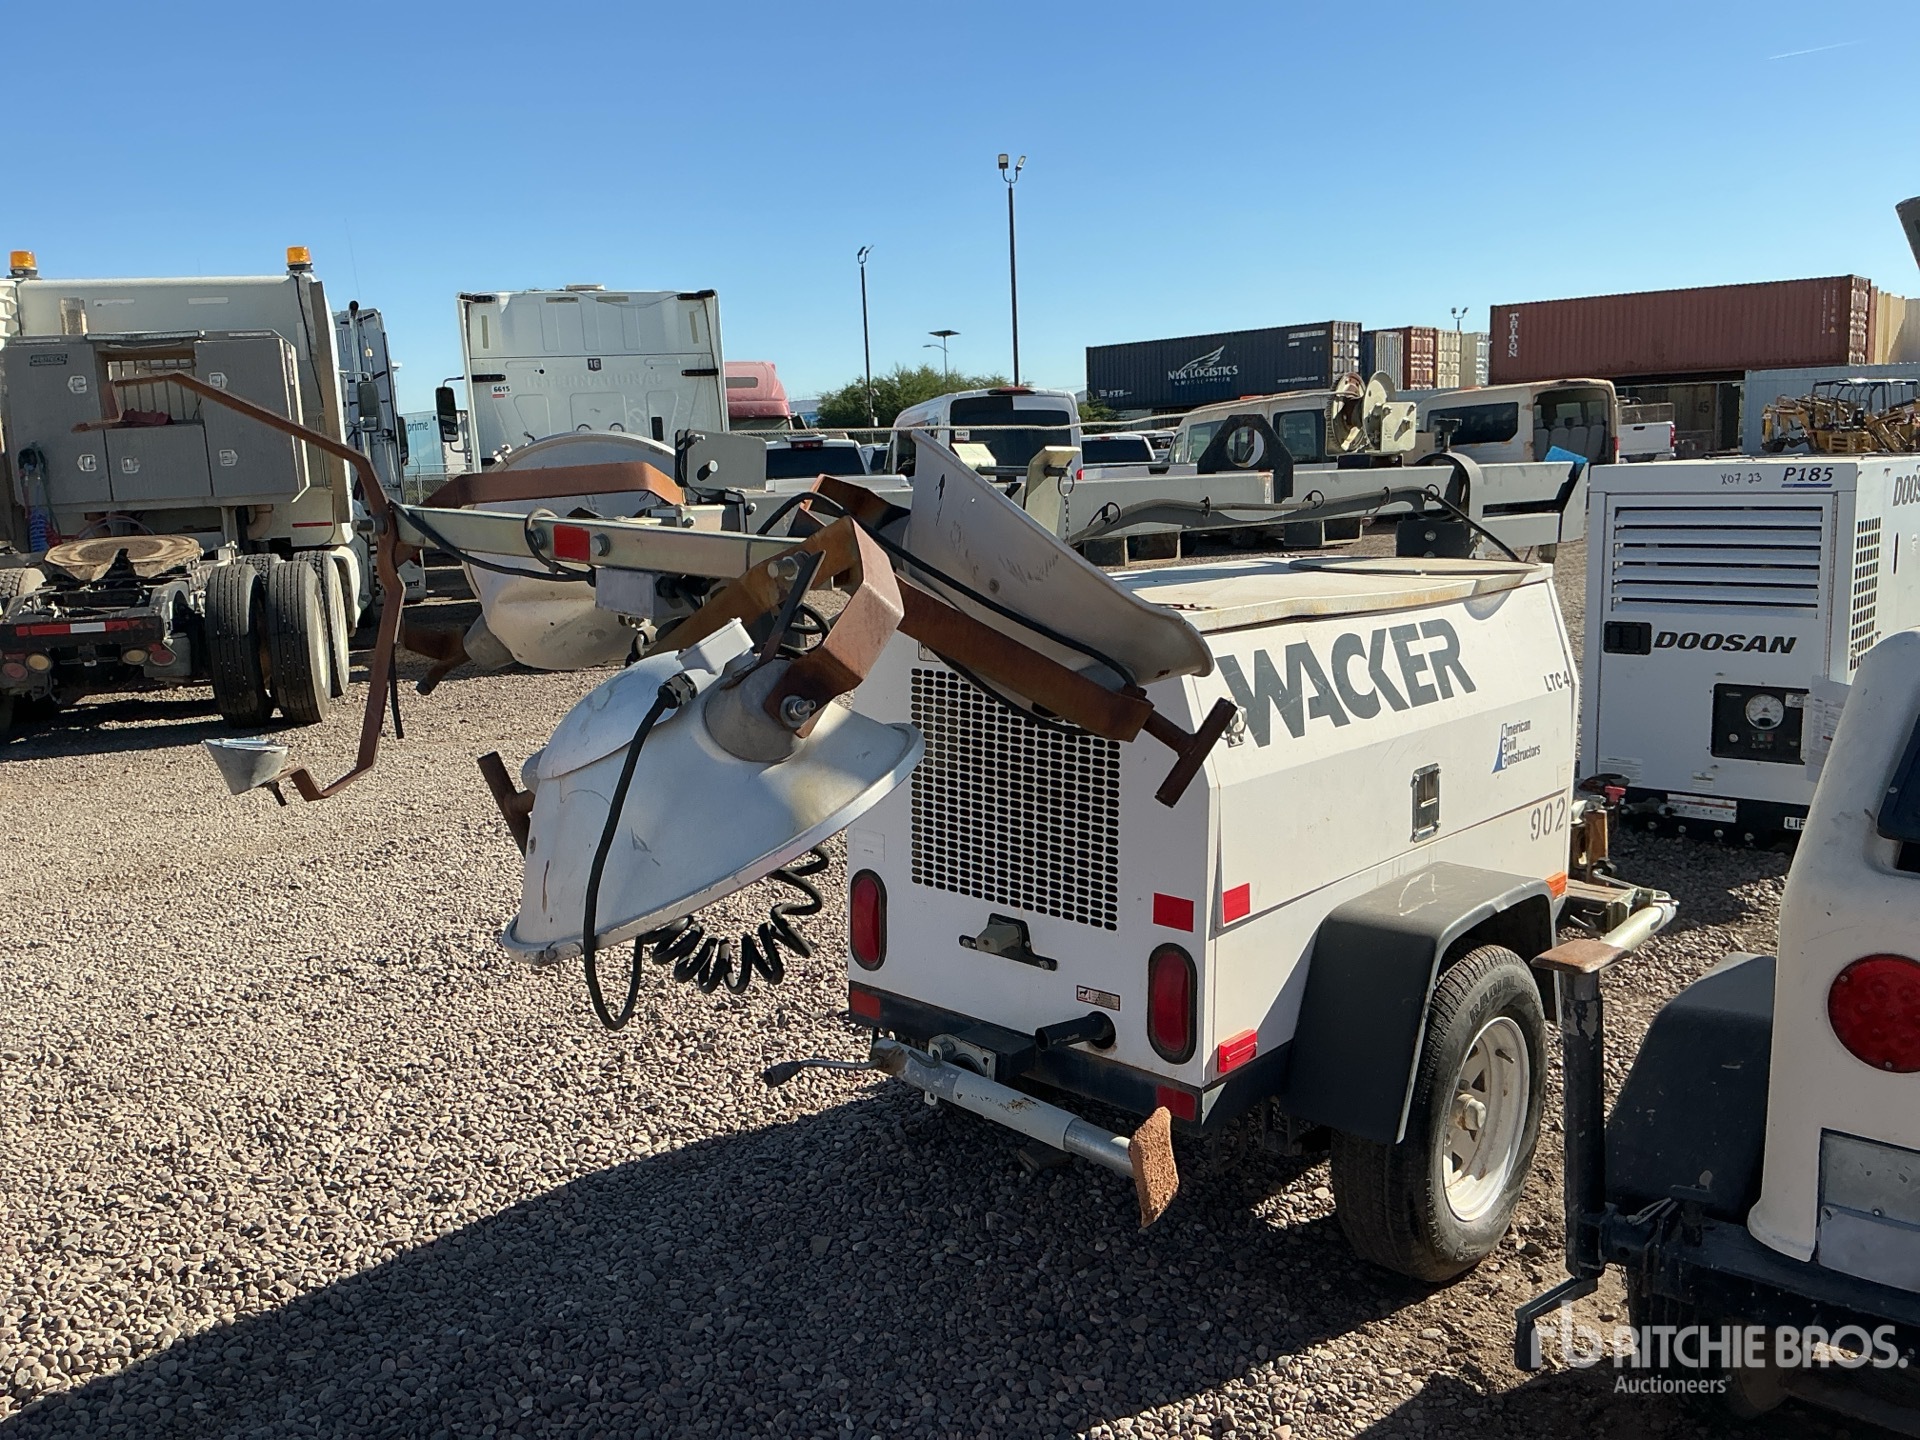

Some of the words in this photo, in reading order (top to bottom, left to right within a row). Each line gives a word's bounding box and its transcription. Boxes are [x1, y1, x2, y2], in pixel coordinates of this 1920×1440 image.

[1508, 312, 1519, 357] TRITON
[588, 359, 600, 369] 16
[1168, 369, 1187, 380] NYK
[1189, 365, 1238, 378] LOGISTICS
[408, 420, 428, 434] prime
[1783, 467, 1834, 482] P185
[1654, 631, 1797, 654] DOOSAN
[1215, 618, 1477, 748] WACKER
[1501, 719, 1531, 740] American
[1501, 738, 1517, 754] Civil
[1501, 744, 1541, 770] Constructors
[1531, 797, 1566, 842] 902
